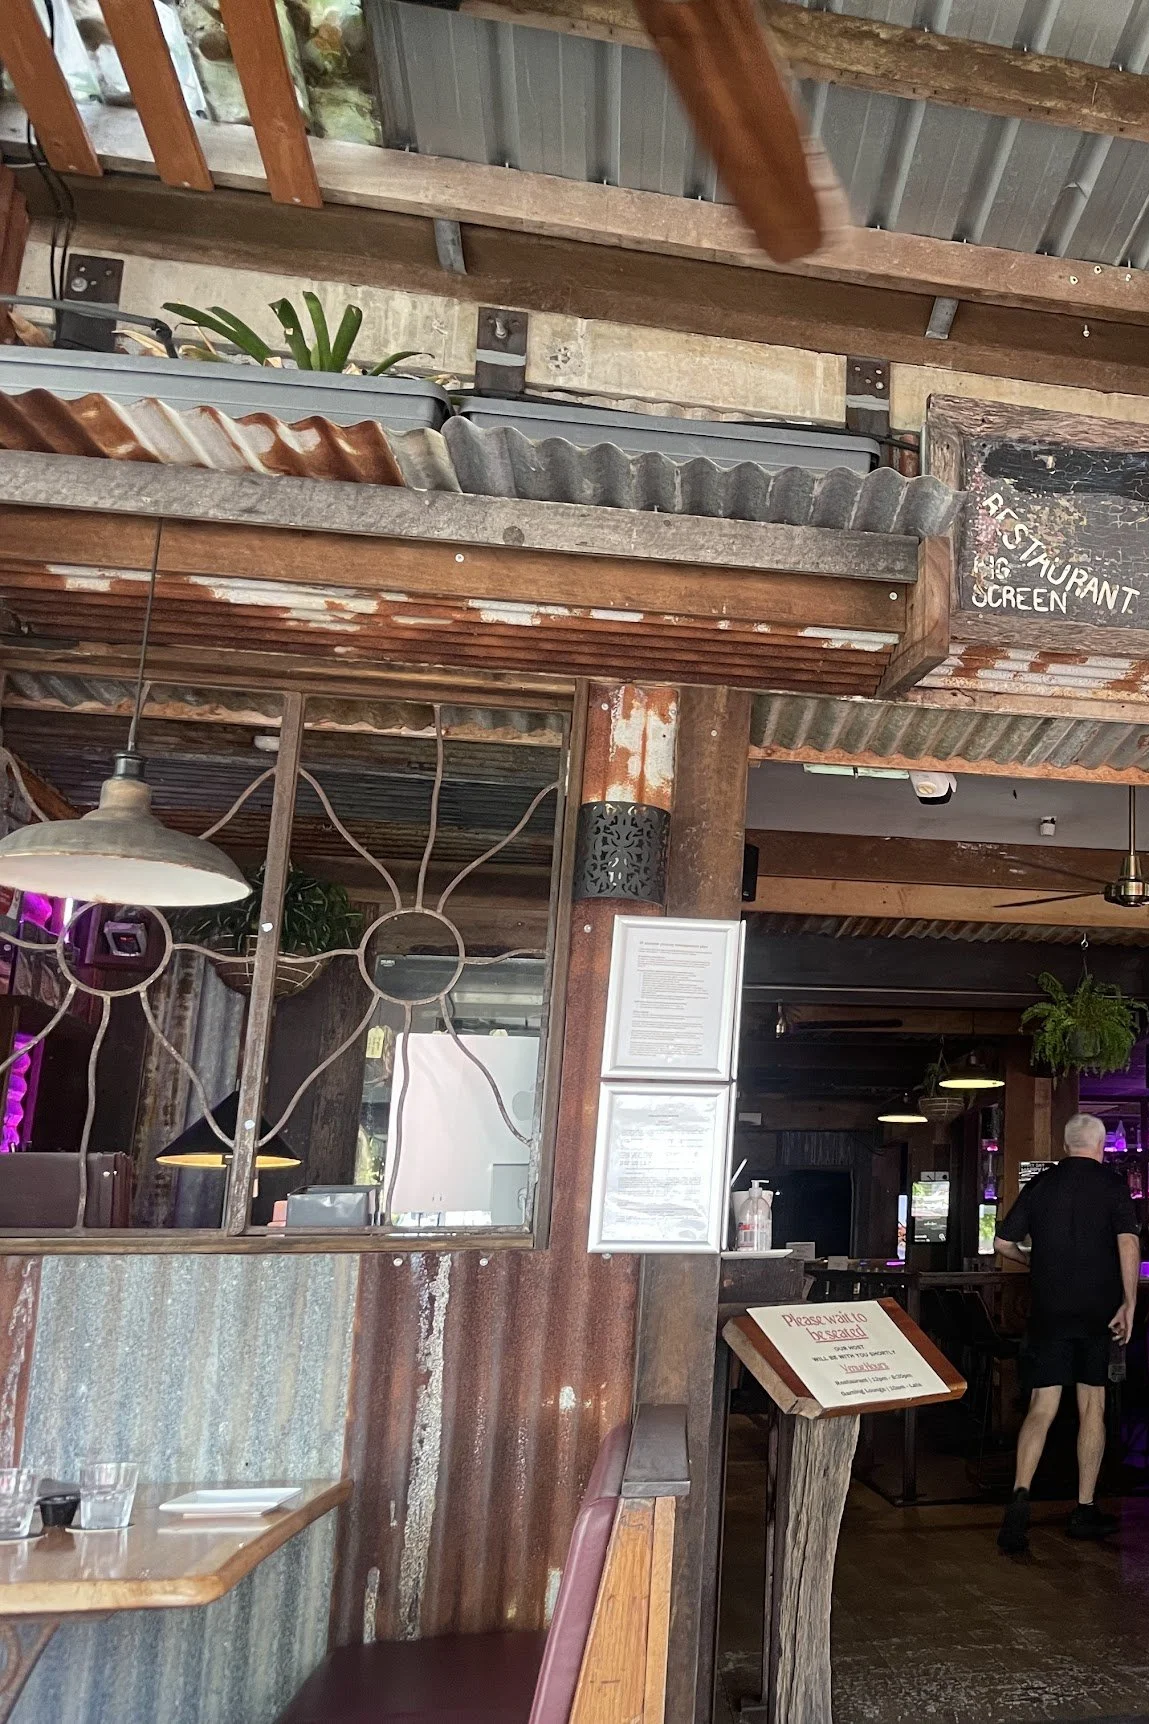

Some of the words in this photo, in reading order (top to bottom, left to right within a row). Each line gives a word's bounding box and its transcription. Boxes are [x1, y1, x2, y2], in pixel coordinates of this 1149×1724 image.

[972, 583, 1067, 614] SCREEN
[782, 1313, 826, 1327] Please
[825, 1311, 851, 1325] wait
[852, 1312, 868, 1323] to
[806, 1327, 827, 1341] be
[827, 1324, 867, 1340] seated
